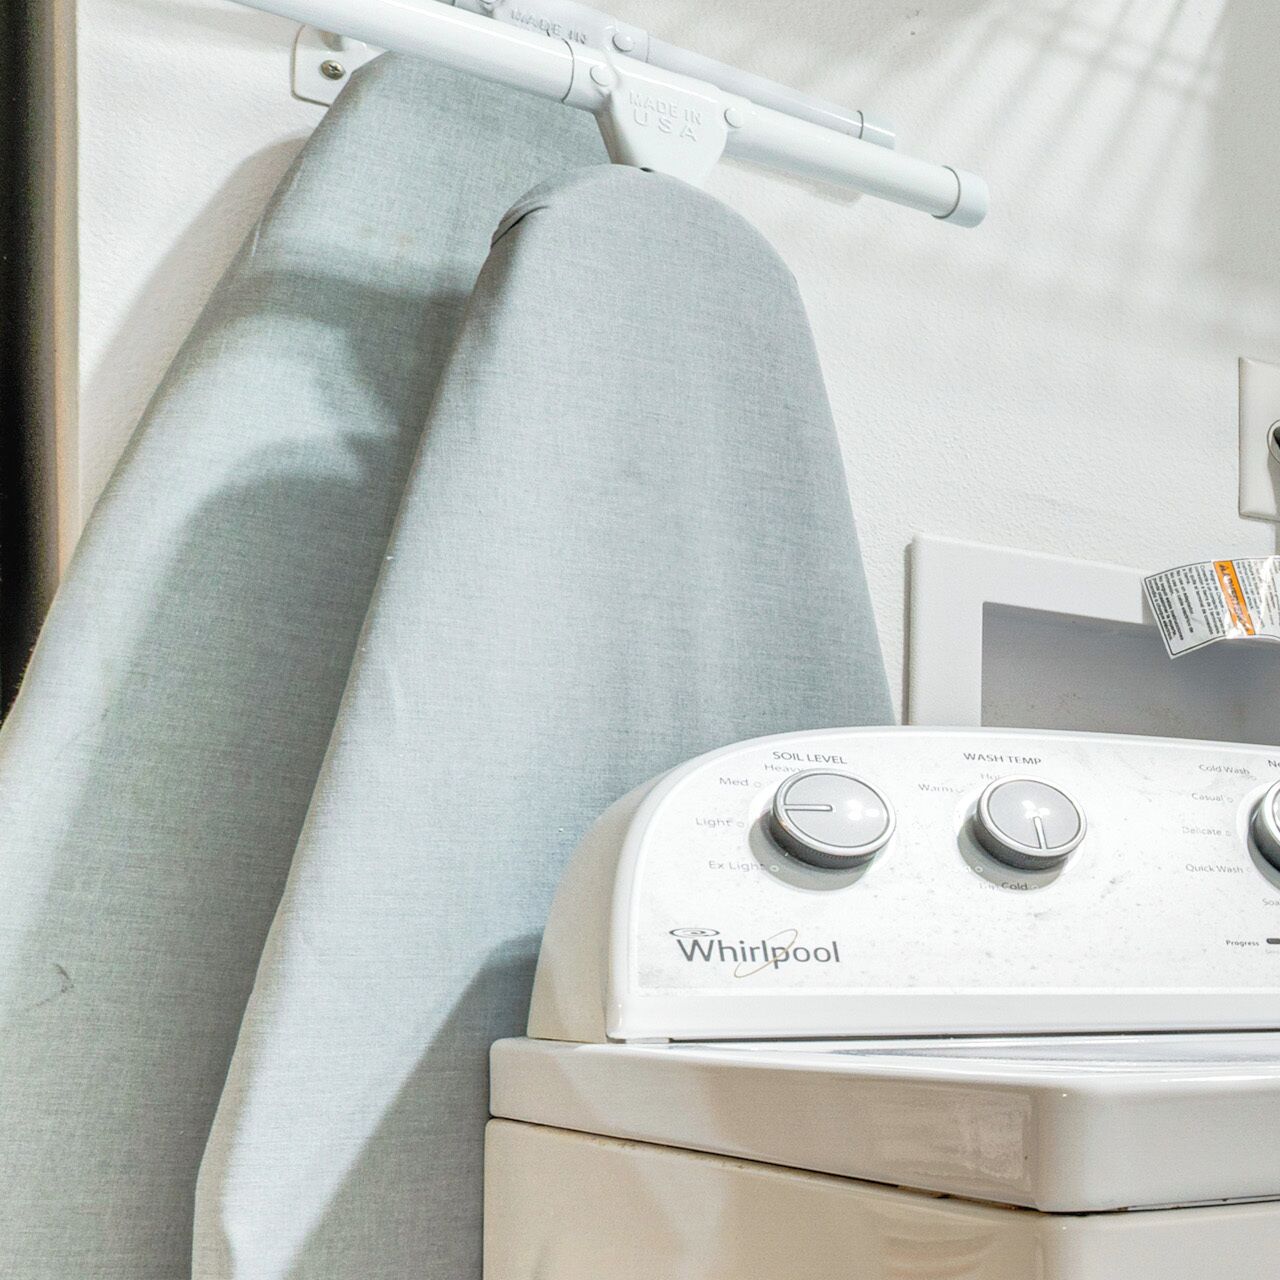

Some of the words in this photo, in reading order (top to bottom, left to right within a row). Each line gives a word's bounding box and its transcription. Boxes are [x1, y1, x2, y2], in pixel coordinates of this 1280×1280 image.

[510, 9, 561, 36] MADE
[568, 30, 587, 44] IN
[630, 90, 678, 118] MADE
[685, 108, 702, 126] IN
[772, 751, 804, 762] SOIL
[806, 753, 848, 765] LEVEL
[963, 752, 1003, 763] WASH
[1007, 754, 1042, 765] TEMP
[1198, 764, 1222, 773] Cold
[1223, 766, 1251, 776] Wash
[719, 777, 749, 787] Med
[1191, 792, 1224, 802] Casual
[695, 817, 732, 829] Light
[1182, 825, 1222, 836] Delicate
[708, 860, 724, 870] Ex
[728, 861, 767, 872] Light
[1185, 863, 1215, 873] Quick
[1216, 864, 1244, 874] Wash
[1001, 880, 1029, 892] Cold
[1226, 939, 1260, 948] Progress
[676, 938, 841, 970] Whirlpool
